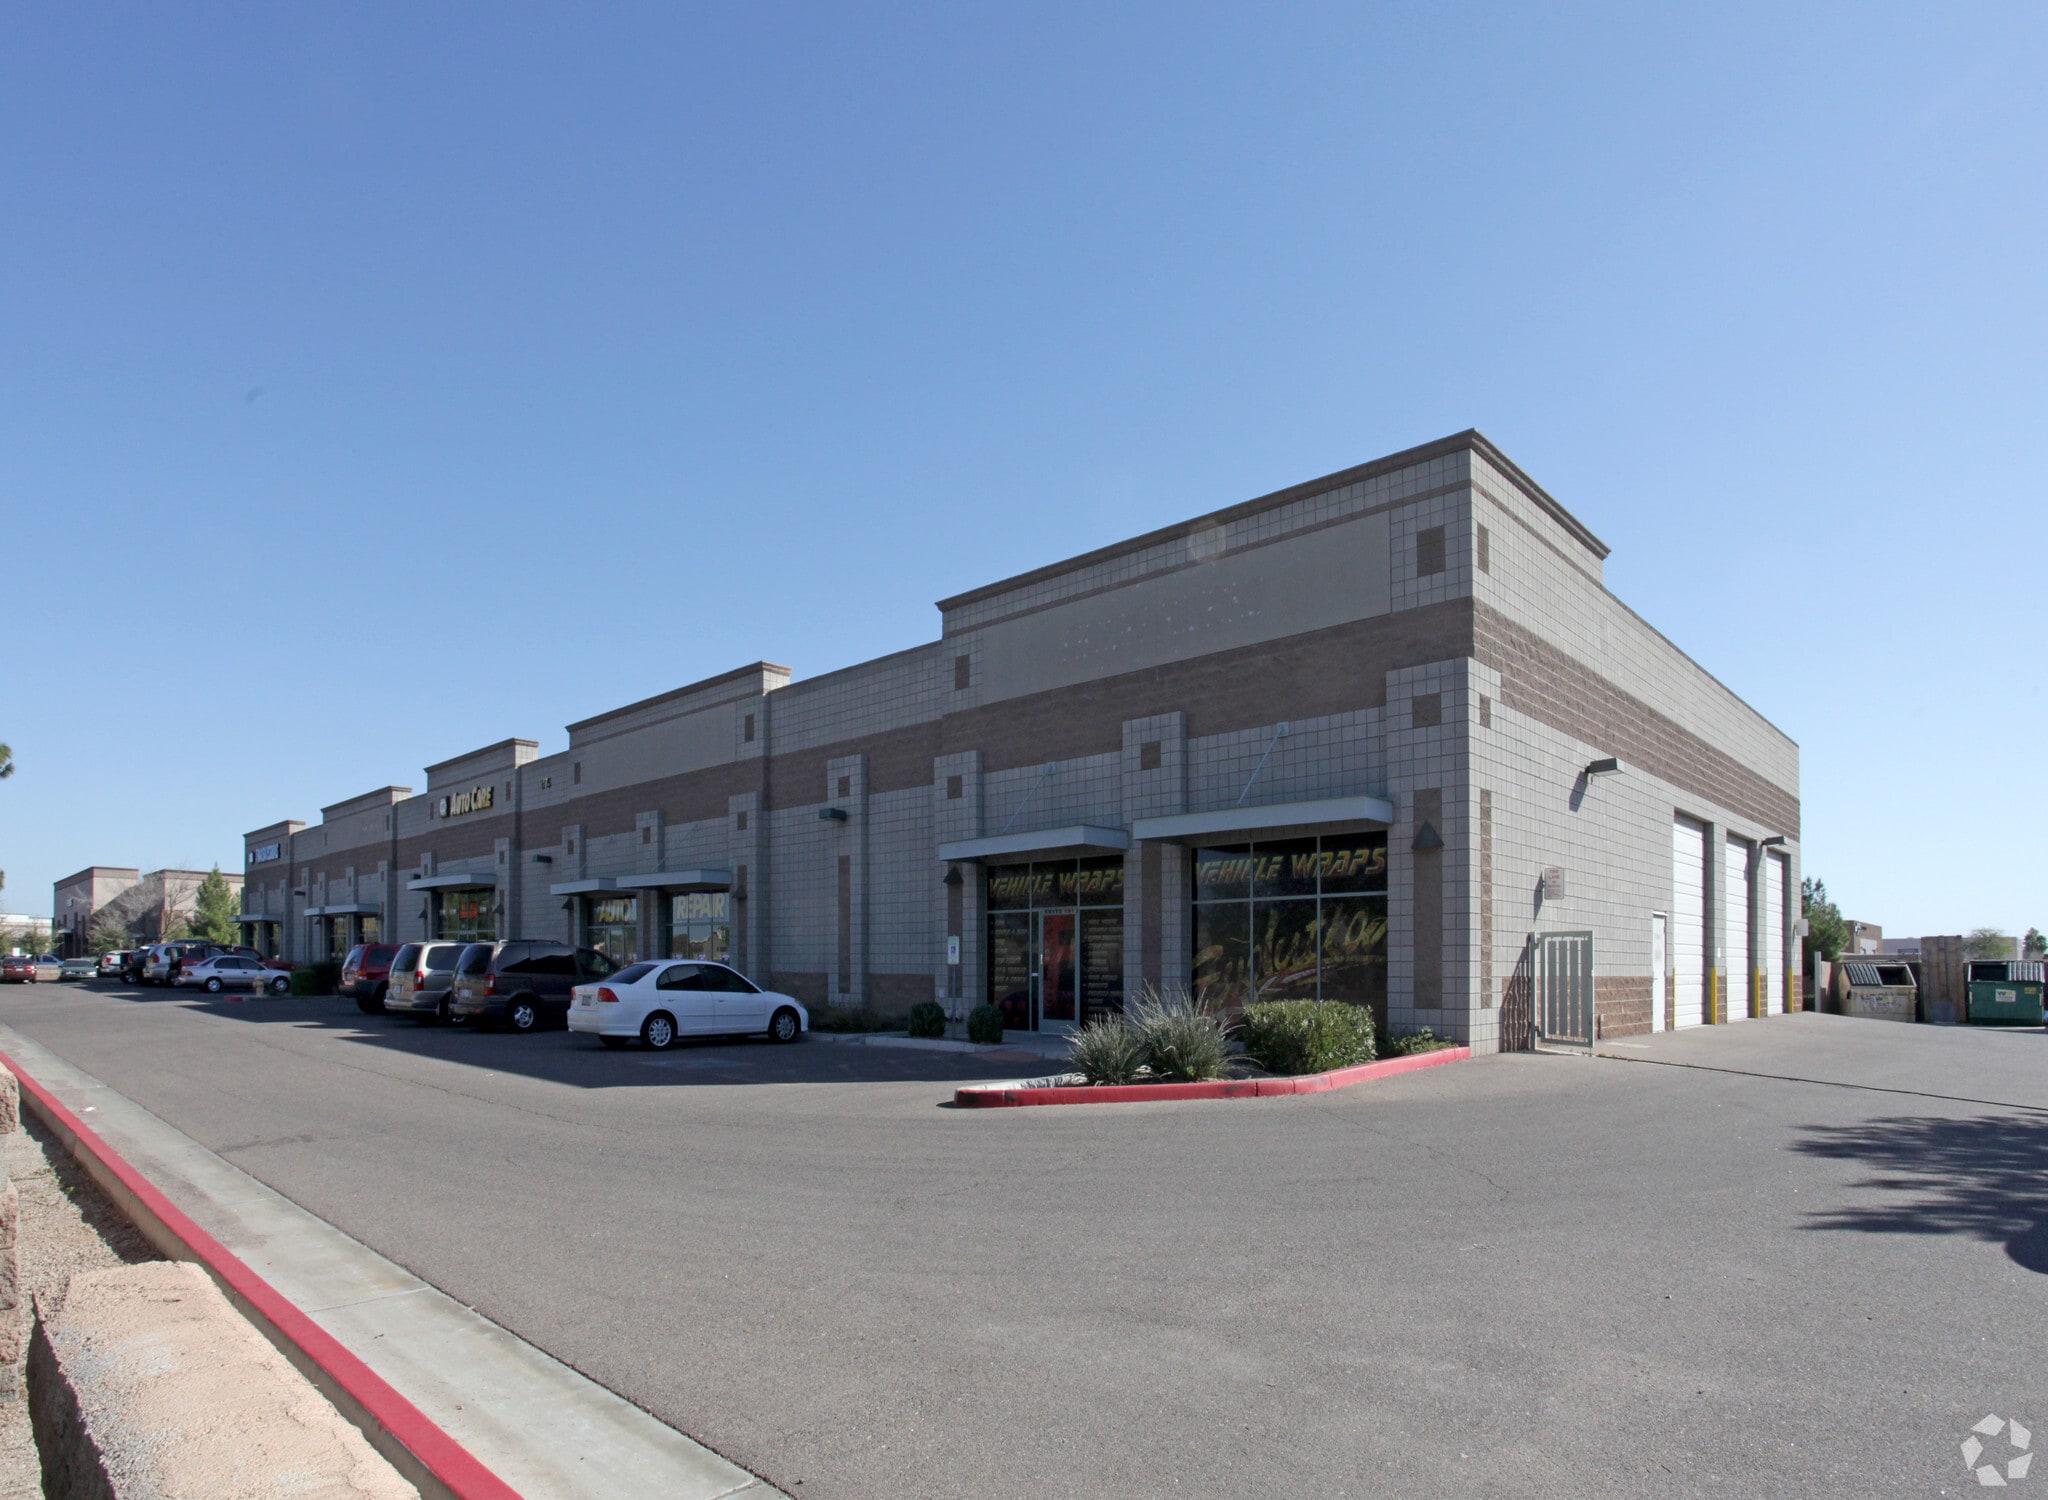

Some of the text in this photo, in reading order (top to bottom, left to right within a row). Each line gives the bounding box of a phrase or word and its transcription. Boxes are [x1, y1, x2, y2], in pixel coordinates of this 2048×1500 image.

[450, 793, 471, 816] AUTO
[471, 786, 492, 811] CARE
[1196, 847, 1387, 885] VEHICLE WRAPS
[989, 869, 1124, 897] VEHICLE WRAPS
[598, 893, 725, 923] AUTO REPAIR
